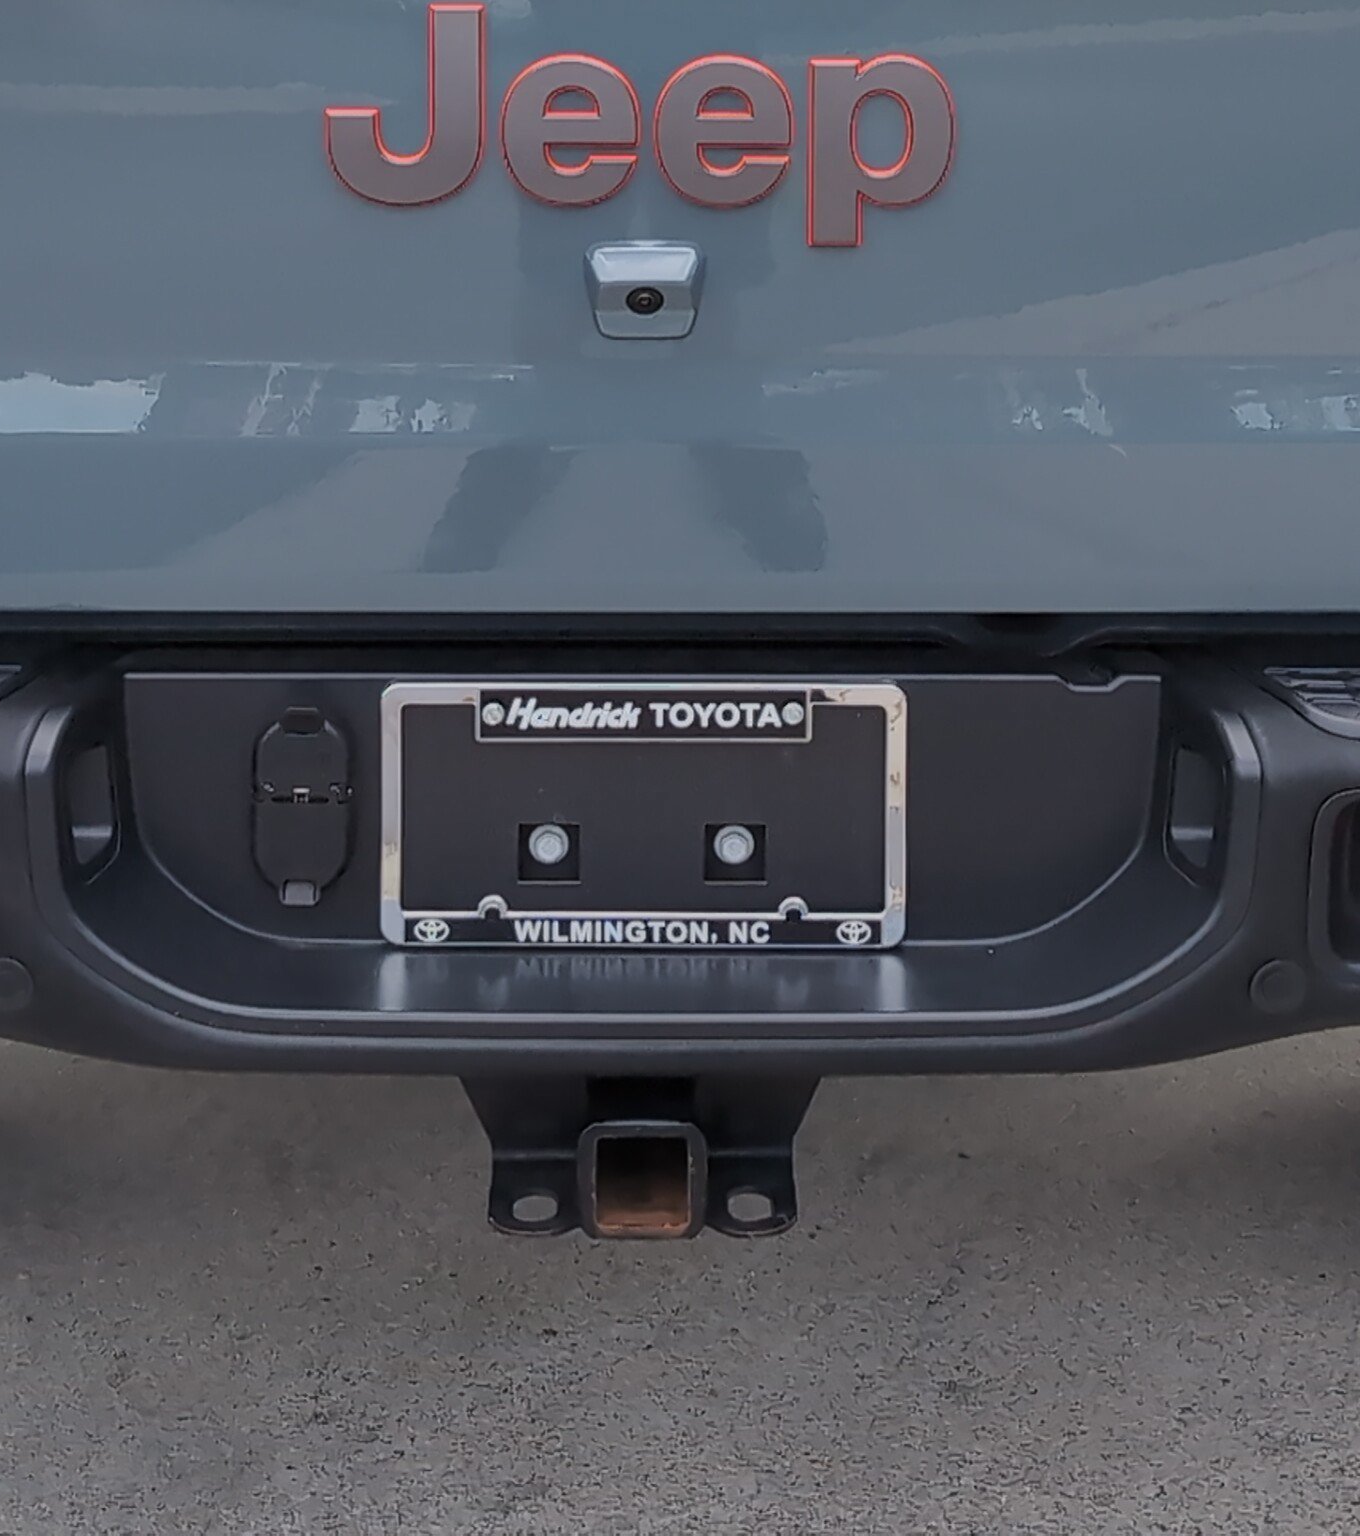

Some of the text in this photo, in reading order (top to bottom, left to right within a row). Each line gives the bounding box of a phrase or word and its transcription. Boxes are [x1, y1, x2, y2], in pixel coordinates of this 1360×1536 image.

[324, 2, 955, 247] Jeep
[505, 697, 782, 730] Hendrick TOYOTA
[515, 921, 771, 944] WILMINGTON, NC
